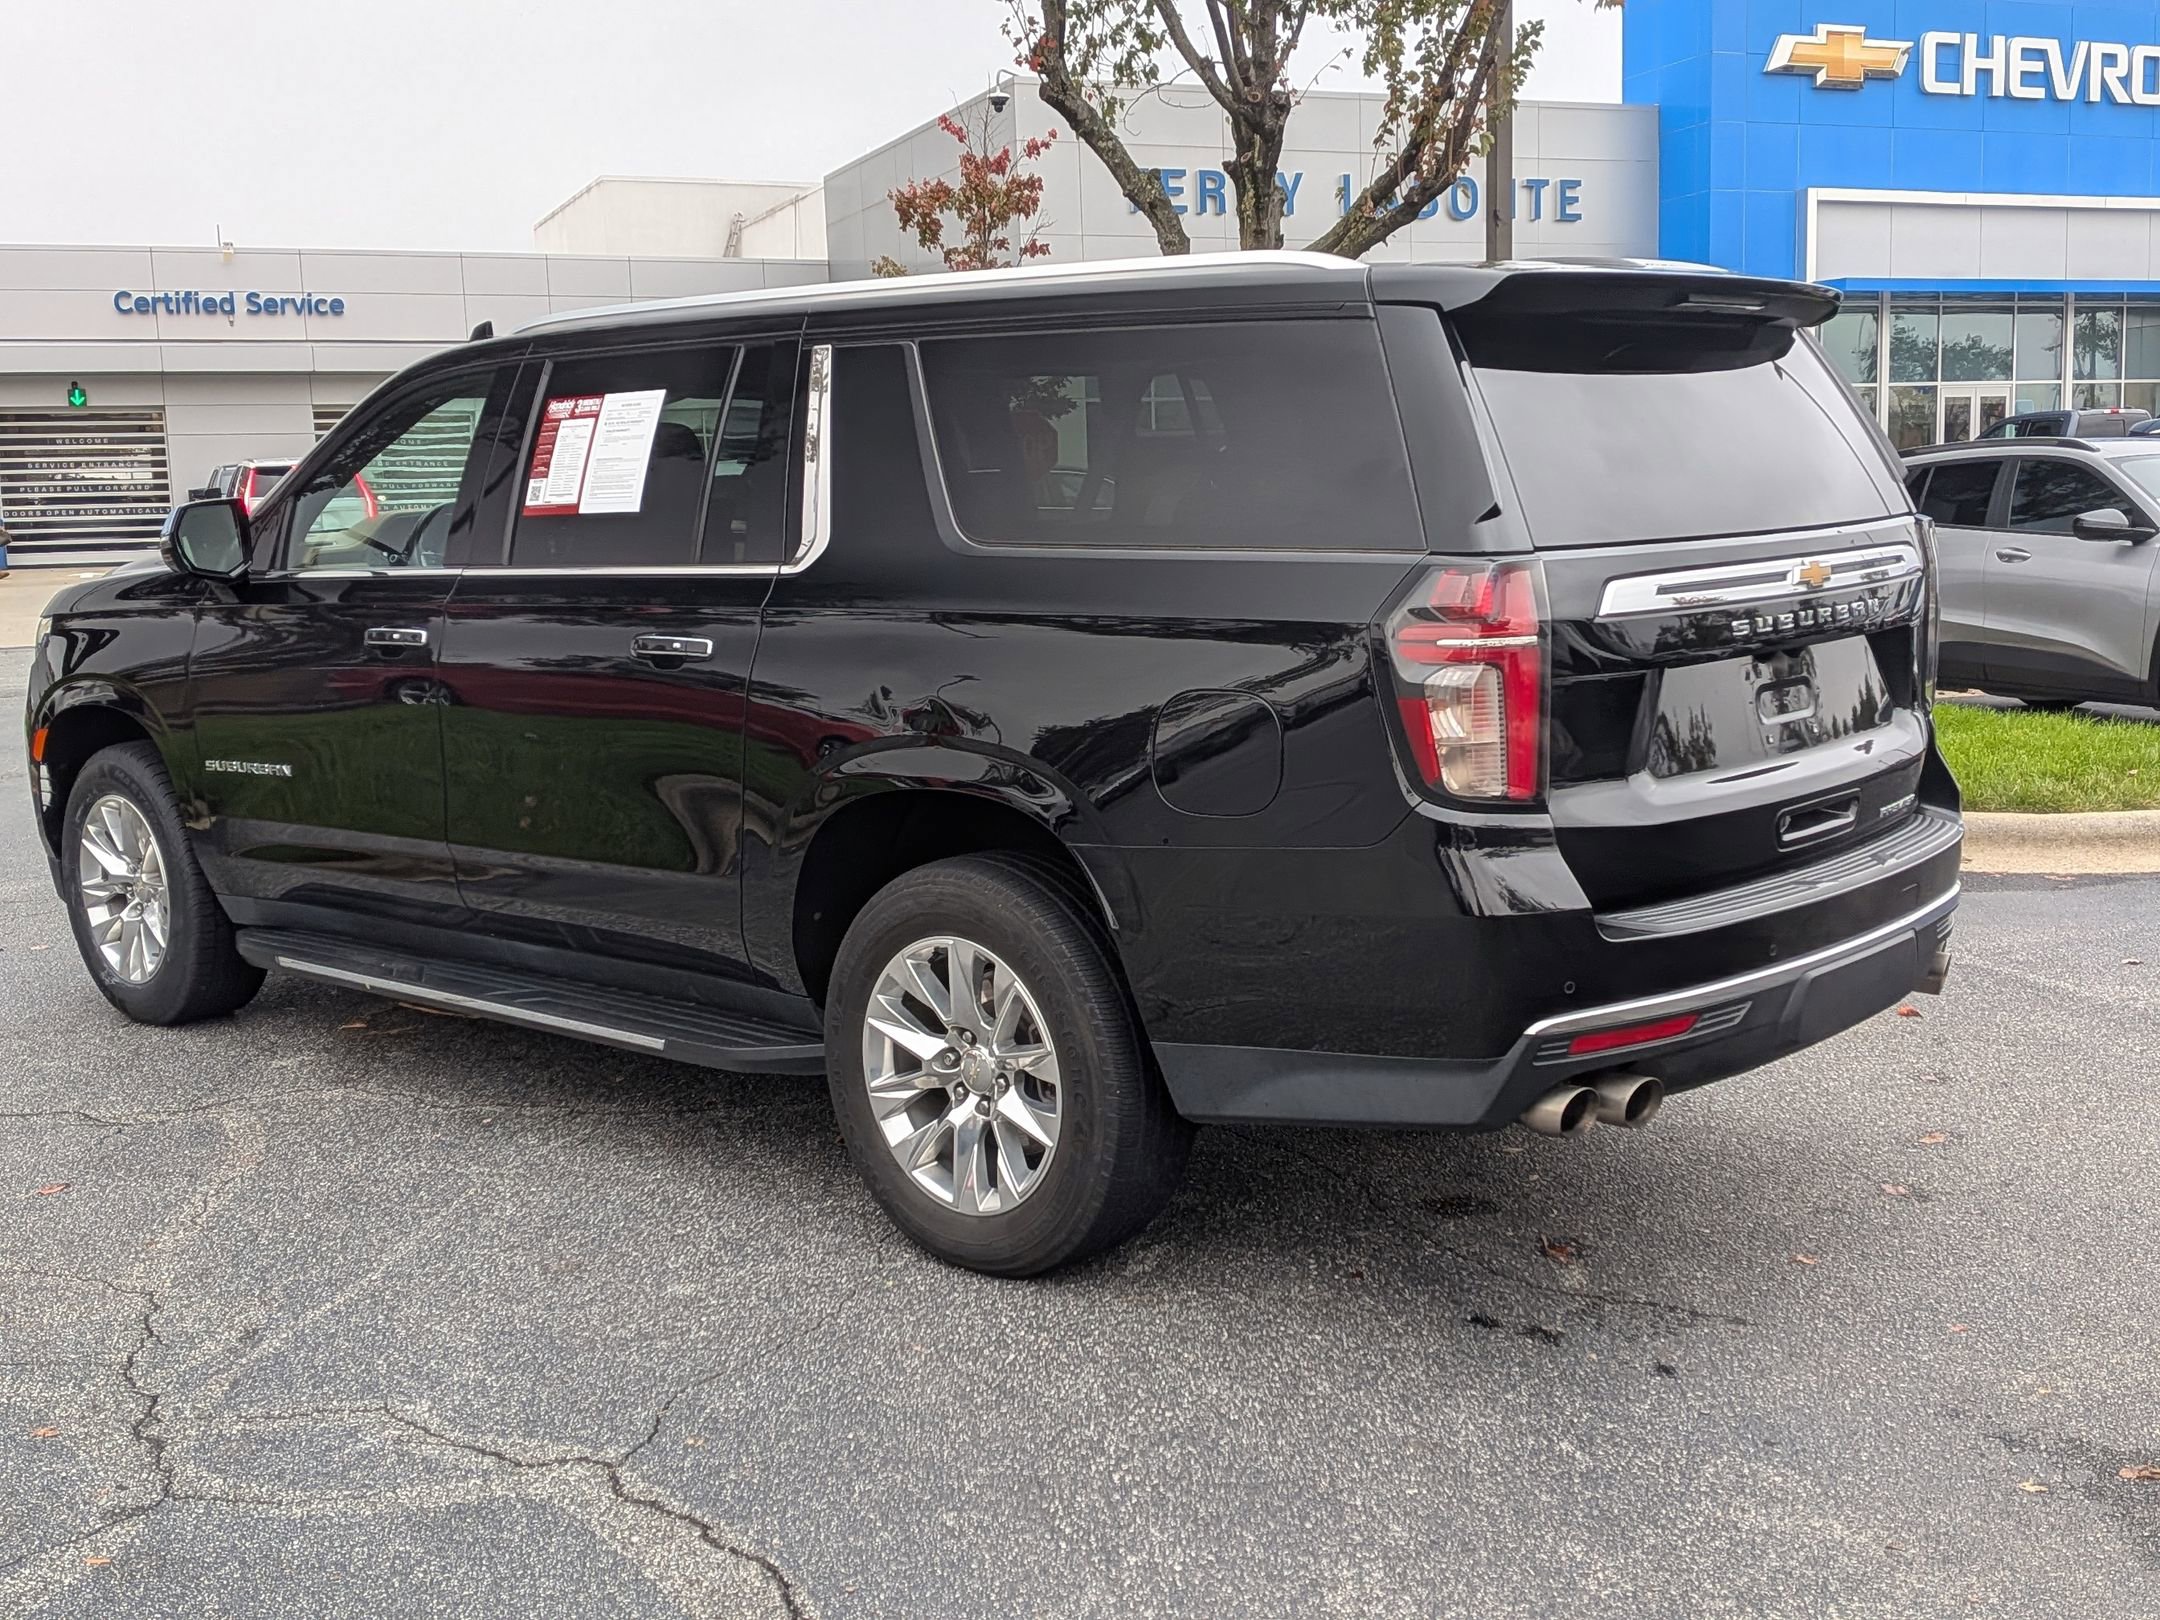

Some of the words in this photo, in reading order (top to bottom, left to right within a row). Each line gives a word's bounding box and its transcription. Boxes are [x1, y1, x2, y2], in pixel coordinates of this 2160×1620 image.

[1919, 31, 2160, 105] CHEVRO
[1130, 168, 1304, 217] ERY
[113, 290, 235, 315] Certified
[246, 292, 345, 316] Service
[55, 437, 109, 445] WELCOME
[27, 461, 75, 469] SERVICE
[98, 484, 150, 492] FORWARD
[1731, 598, 1882, 637] SUBURBAN
[204, 759, 293, 777] SUBURBAN
